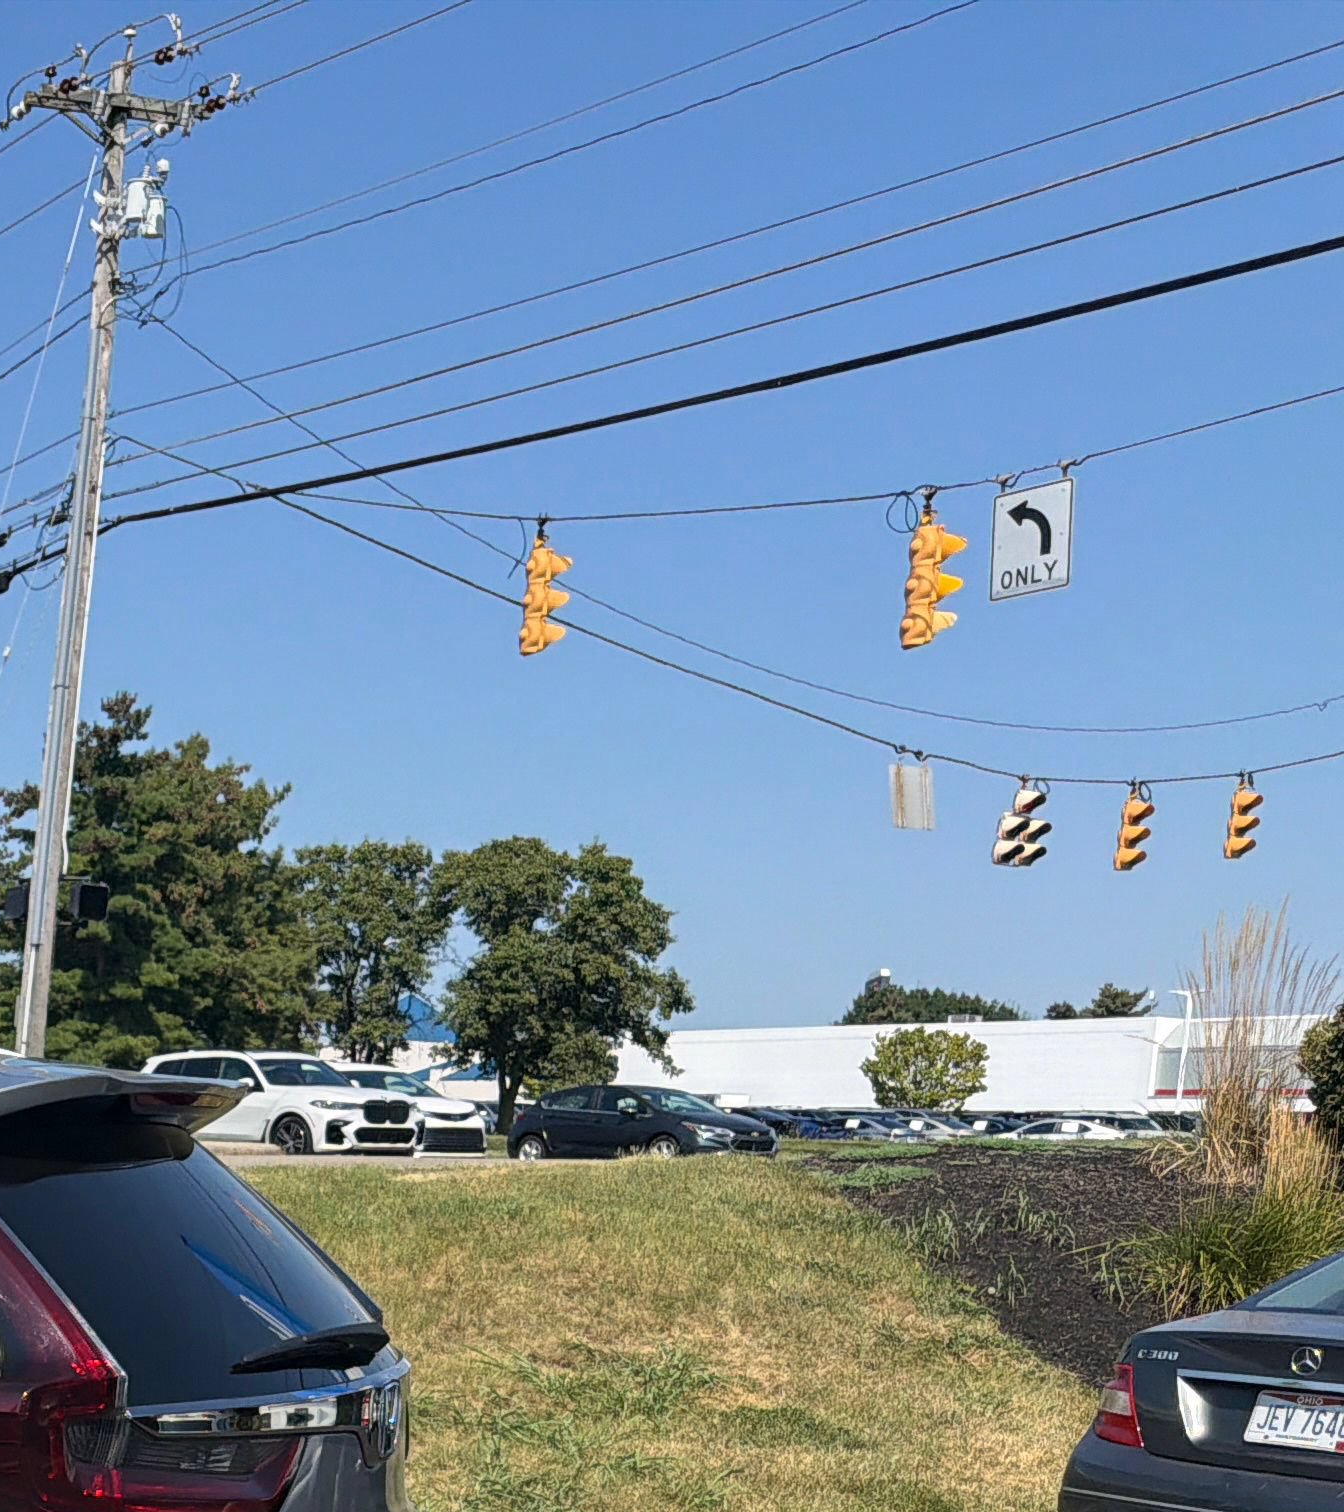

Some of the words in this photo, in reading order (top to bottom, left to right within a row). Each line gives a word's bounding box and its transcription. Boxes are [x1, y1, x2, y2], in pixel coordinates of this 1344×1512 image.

[1000, 560, 1058, 590] ONLY
[1296, 1395, 1324, 1406] OHIO
[1256, 1404, 1297, 1433] JEV
